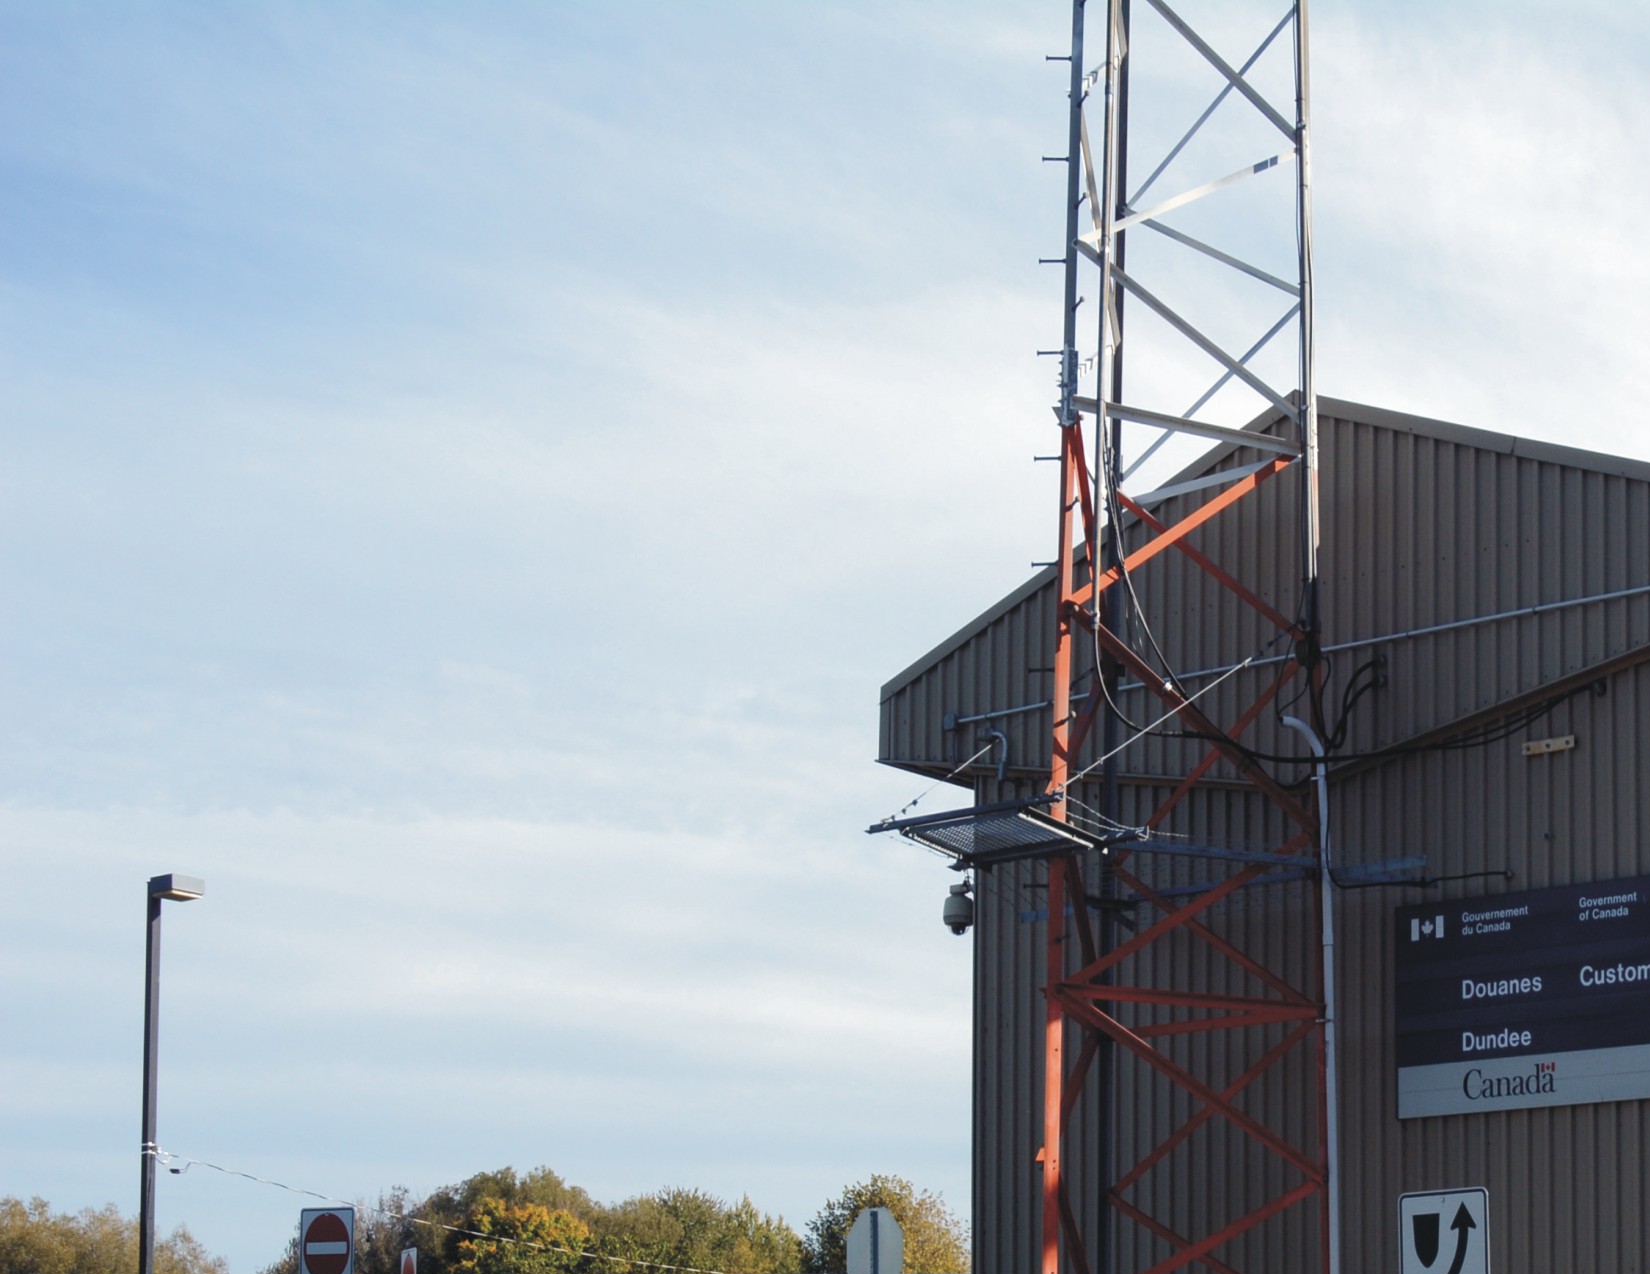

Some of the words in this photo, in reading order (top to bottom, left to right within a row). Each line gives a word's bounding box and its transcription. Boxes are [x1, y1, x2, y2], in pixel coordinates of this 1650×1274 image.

[1579, 891, 1637, 908] Government
[1461, 905, 1529, 923] Gouvernement
[1579, 910, 1590, 921] of
[1592, 906, 1629, 920] Canada
[1461, 924, 1474, 936] du
[1476, 921, 1511, 934] Canada
[1462, 975, 1543, 1000] Douanes
[1462, 1028, 1532, 1051] Dundee
[1462, 1063, 1556, 1100] Canada
